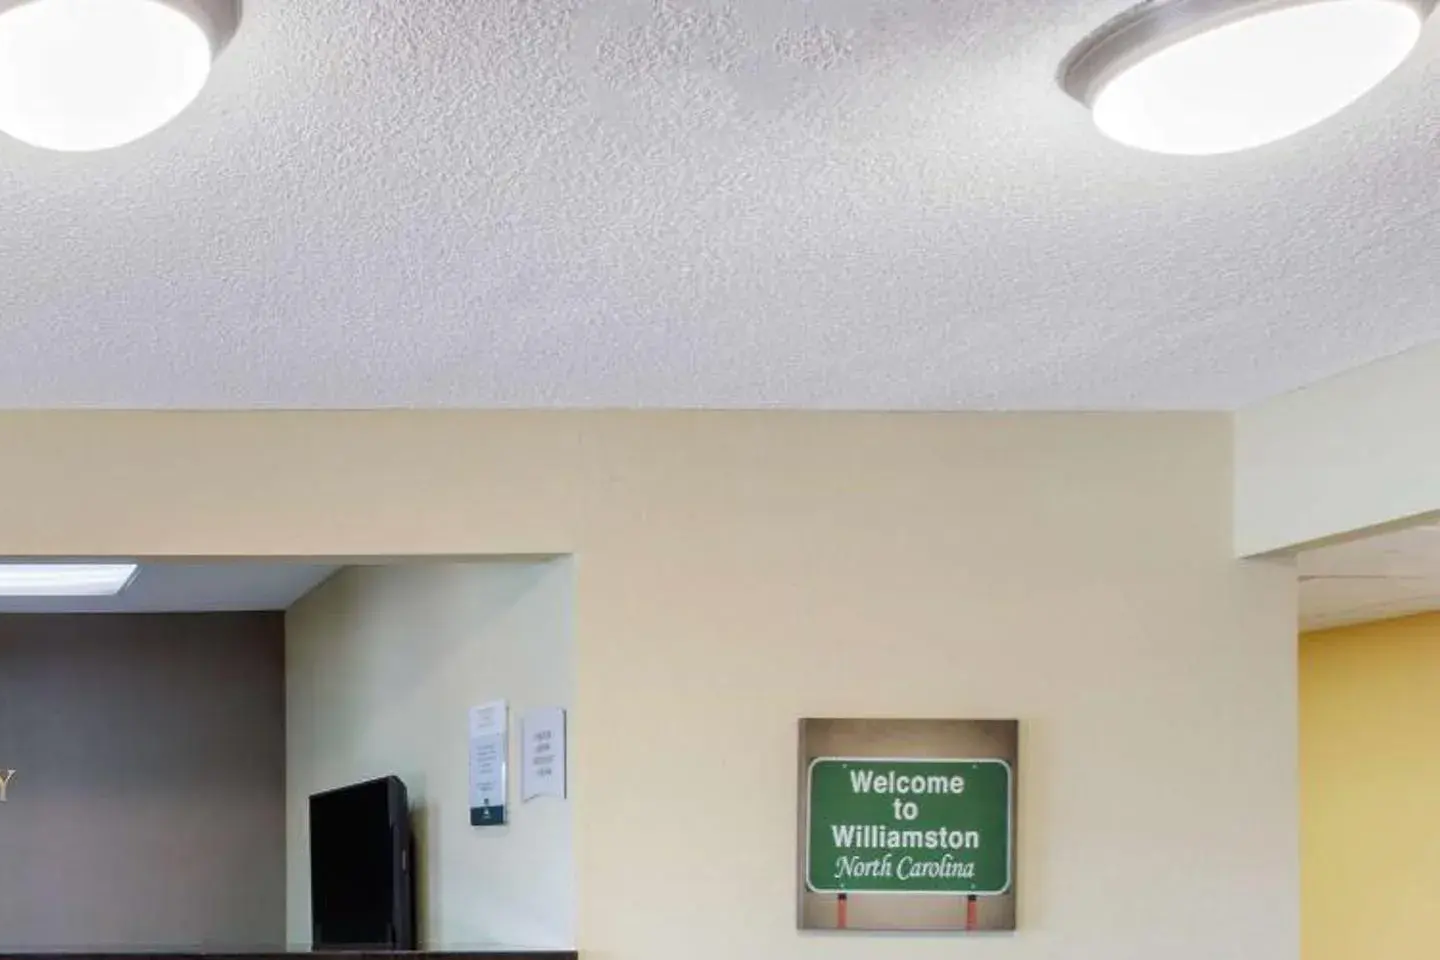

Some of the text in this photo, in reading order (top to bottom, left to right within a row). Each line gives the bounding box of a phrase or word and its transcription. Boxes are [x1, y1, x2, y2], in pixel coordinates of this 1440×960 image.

[850, 769, 964, 794] Welcome
[892, 798, 919, 820] to
[830, 824, 980, 849] Williamston
[834, 853, 976, 881] North Carolina
